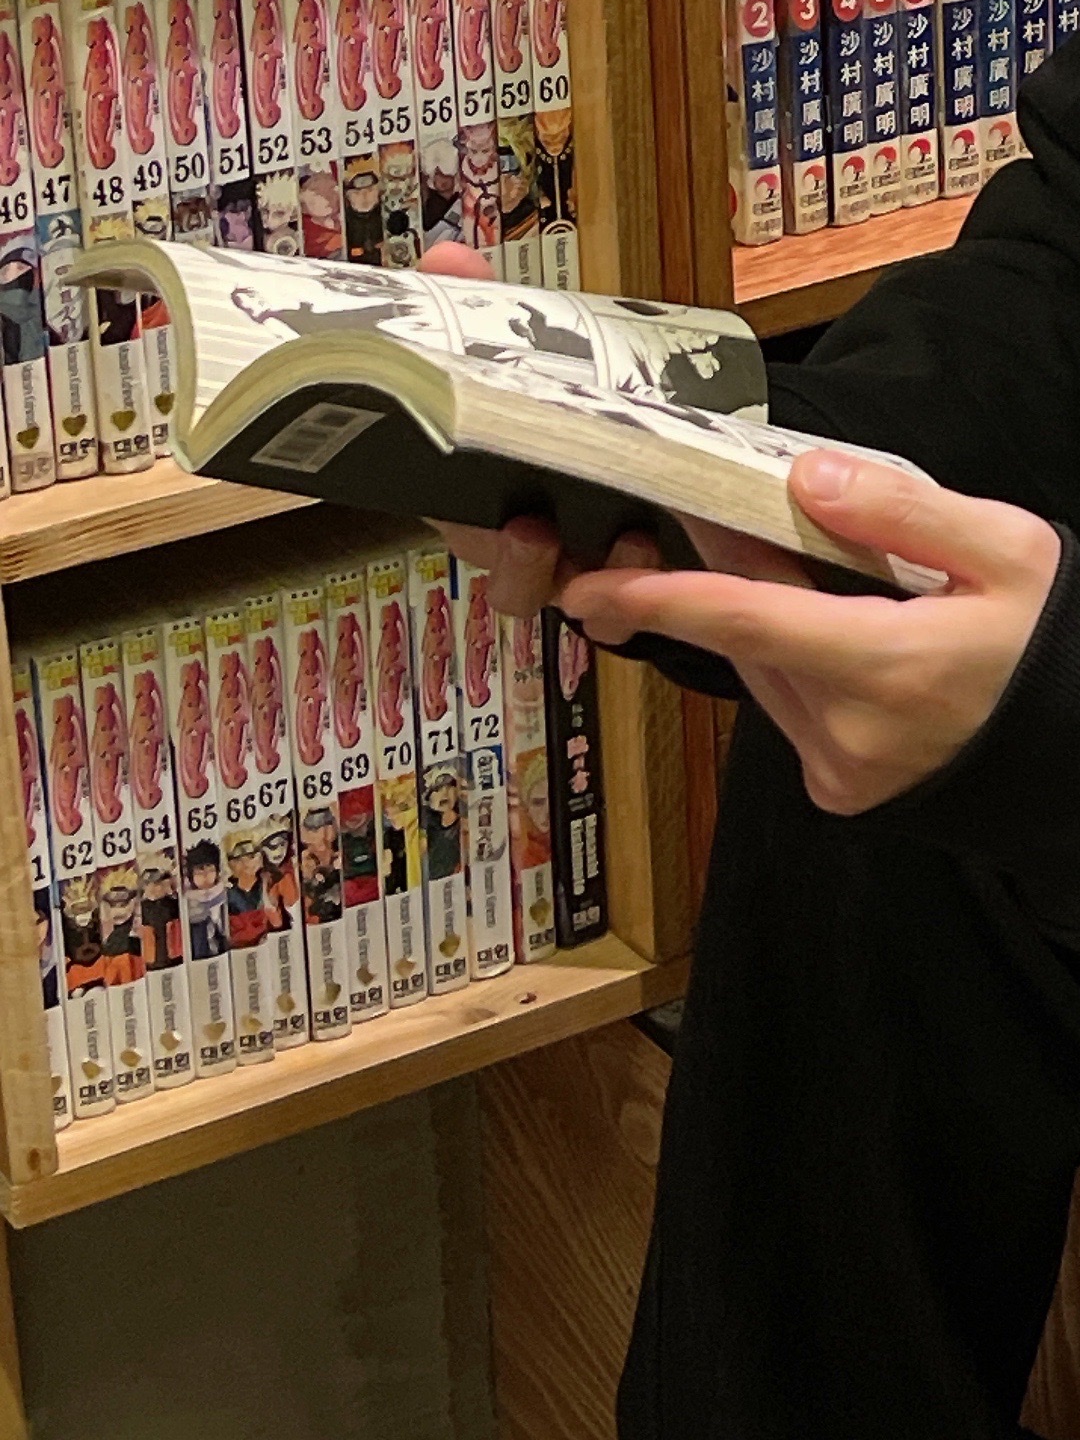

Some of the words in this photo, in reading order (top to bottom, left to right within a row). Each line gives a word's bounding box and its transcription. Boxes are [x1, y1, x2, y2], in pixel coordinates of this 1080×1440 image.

[752, 1, 768, 28] 2
[907, 13, 930, 127] 沙村廣明
[951, 6, 975, 119] 沙村廣明
[539, 75, 569, 103] 60
[840, 30, 864, 144] 沙村廣明
[872, 21, 896, 135] 沙村廣明
[463, 86, 495, 117] 57
[500, 79, 530, 110] 59
[750, 47, 779, 162] 沙村廣明
[799, 38, 824, 154] 沙村廣明
[379, 106, 411, 136] 55
[422, 96, 453, 126] 56
[300, 126, 333, 156] 53
[345, 117, 375, 147] 54
[219, 143, 249, 174] 51
[258, 134, 289, 164] 52
[133, 160, 163, 192] 49
[174, 152, 205, 183] 50
[42, 174, 71, 205] 47
[92, 176, 125, 207] 48
[0, 192, 29, 224] 46
[470, 714, 500, 742] 72
[384, 742, 412, 771] 70
[427, 730, 455, 758] 71
[340, 753, 369, 782] 69
[259, 778, 288, 807] 67
[303, 771, 333, 800] 68
[188, 803, 218, 832] 65
[226, 794, 257, 823] 66
[102, 827, 132, 858] 63
[140, 814, 171, 843] 64
[62, 840, 93, 869] 62
